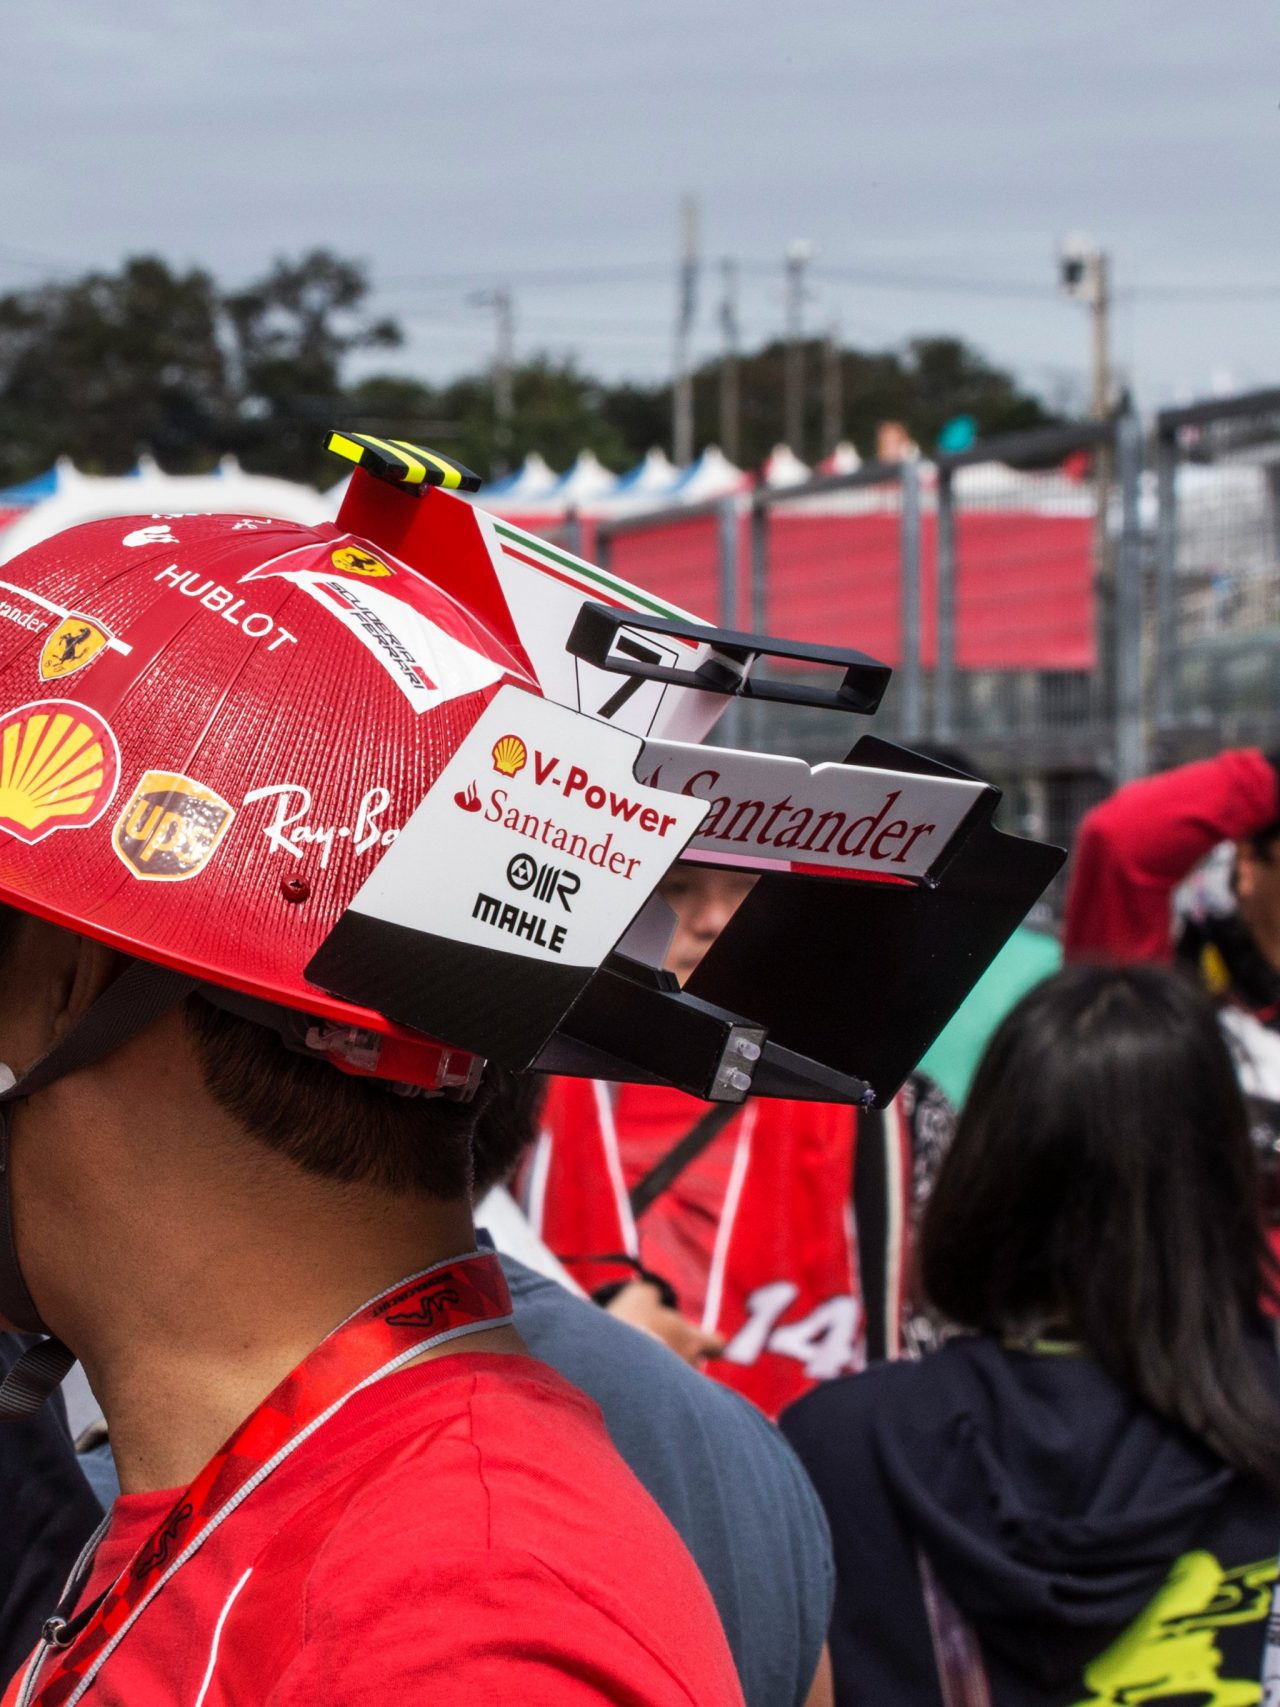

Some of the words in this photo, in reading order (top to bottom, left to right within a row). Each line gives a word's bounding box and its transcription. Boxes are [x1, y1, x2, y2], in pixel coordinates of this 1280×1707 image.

[153, 563, 298, 651] HUBLOT
[326, 581, 417, 664] SCUDERIA
[350, 612, 425, 689] FERRARI
[597, 634, 663, 720] 7
[484, 789, 642, 881] Santander
[534, 749, 678, 838] V-Power
[471, 892, 568, 954] MAHLE
[724, 1280, 858, 1380] 14
